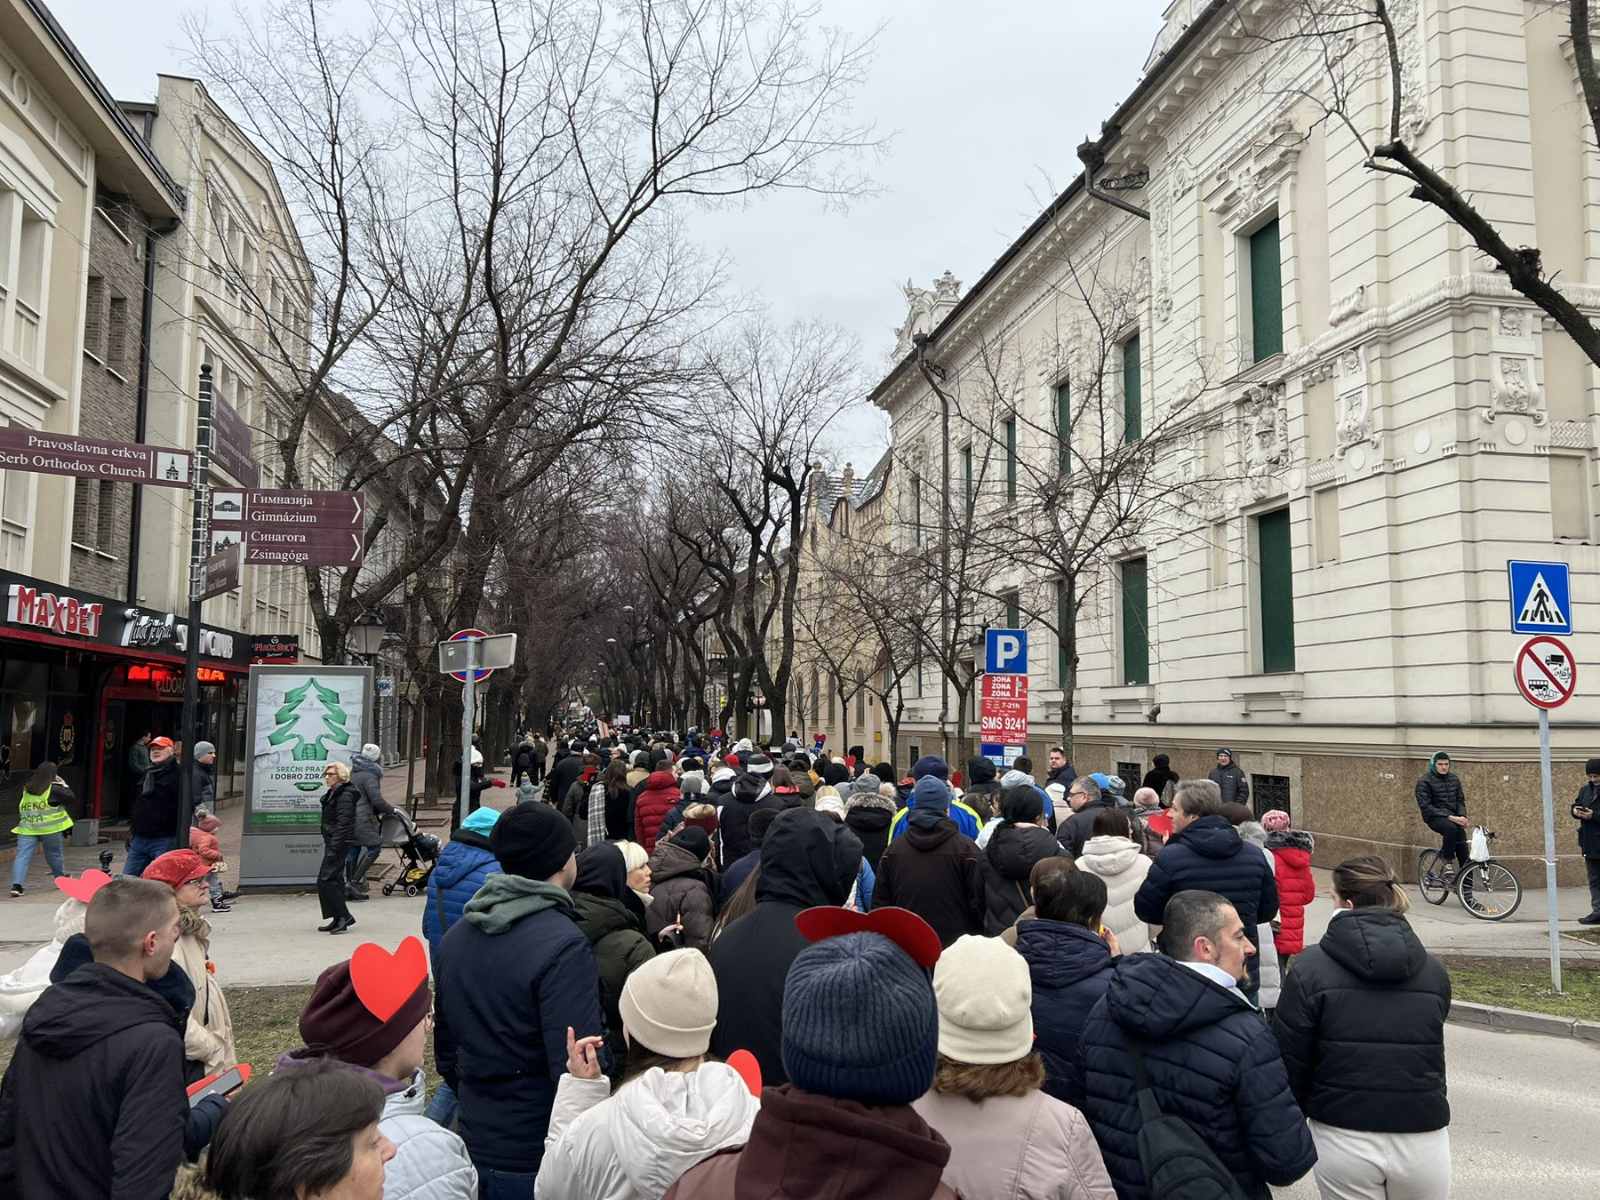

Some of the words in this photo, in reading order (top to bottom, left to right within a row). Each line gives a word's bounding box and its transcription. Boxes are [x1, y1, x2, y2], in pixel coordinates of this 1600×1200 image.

[28, 435, 108, 455] Pravoslavna
[111, 447, 146, 460] crkva
[32, 455, 96, 473] Orthodox
[99, 463, 146, 478] Church
[252, 493, 313, 507] Гимназија
[251, 510, 317, 524] Gimnázium
[251, 530, 306, 544] Синагога
[250, 548, 309, 562] Zsinagóga
[996, 635, 1020, 669] P
[982, 716, 1003, 729] SMS
[1004, 717, 1026, 730] 9241
